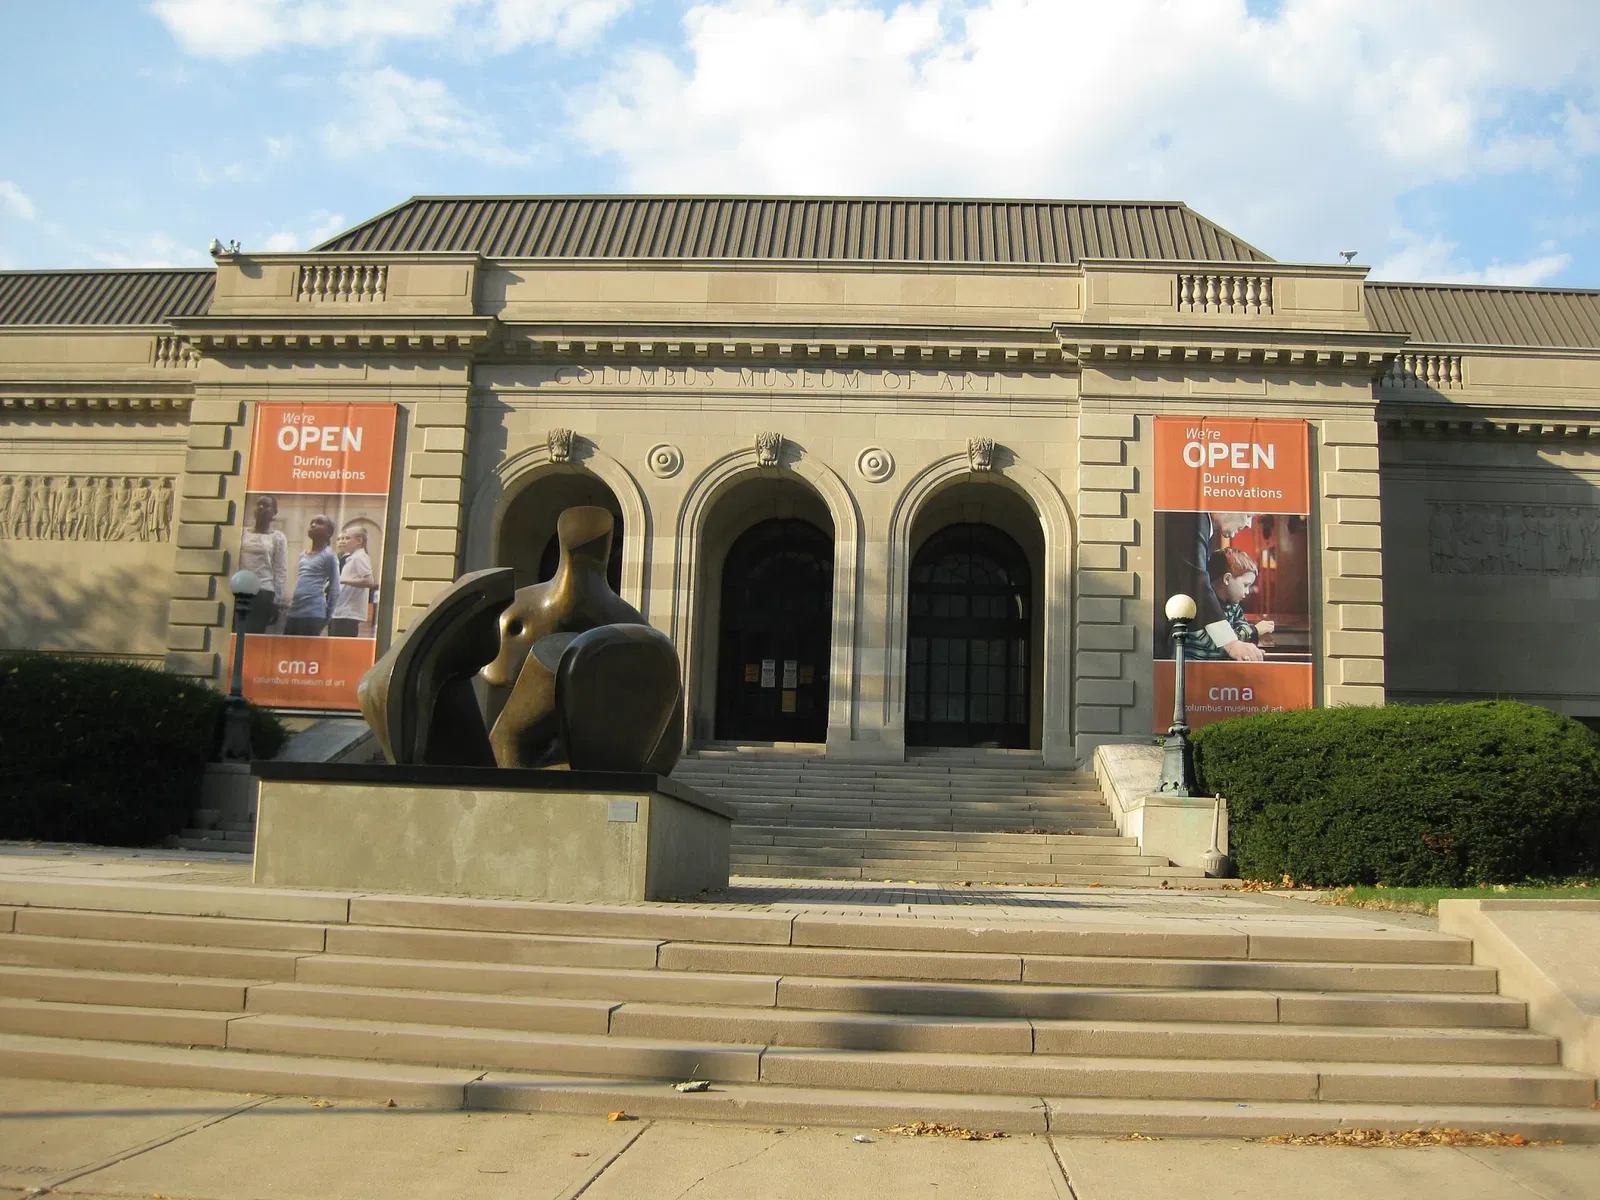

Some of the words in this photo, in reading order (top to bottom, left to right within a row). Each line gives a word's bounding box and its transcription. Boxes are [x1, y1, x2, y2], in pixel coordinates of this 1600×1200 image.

[554, 366, 715, 387] COLUMBUS
[737, 367, 860, 389] MUSEUM
[883, 371, 917, 390] OF
[939, 372, 993, 391] ART
[282, 413, 315, 424] We're
[278, 426, 363, 451] OPEN
[1186, 428, 1221, 440] We're
[293, 455, 333, 468] During
[1183, 442, 1275, 469] OPEN
[292, 468, 366, 480] Renovations
[1203, 472, 1245, 486] During
[1203, 486, 1283, 499] Renovations
[278, 660, 319, 674] cma
[291, 677, 324, 686] museum
[1208, 686, 1253, 701] cma
[1224, 704, 1259, 713] museum
